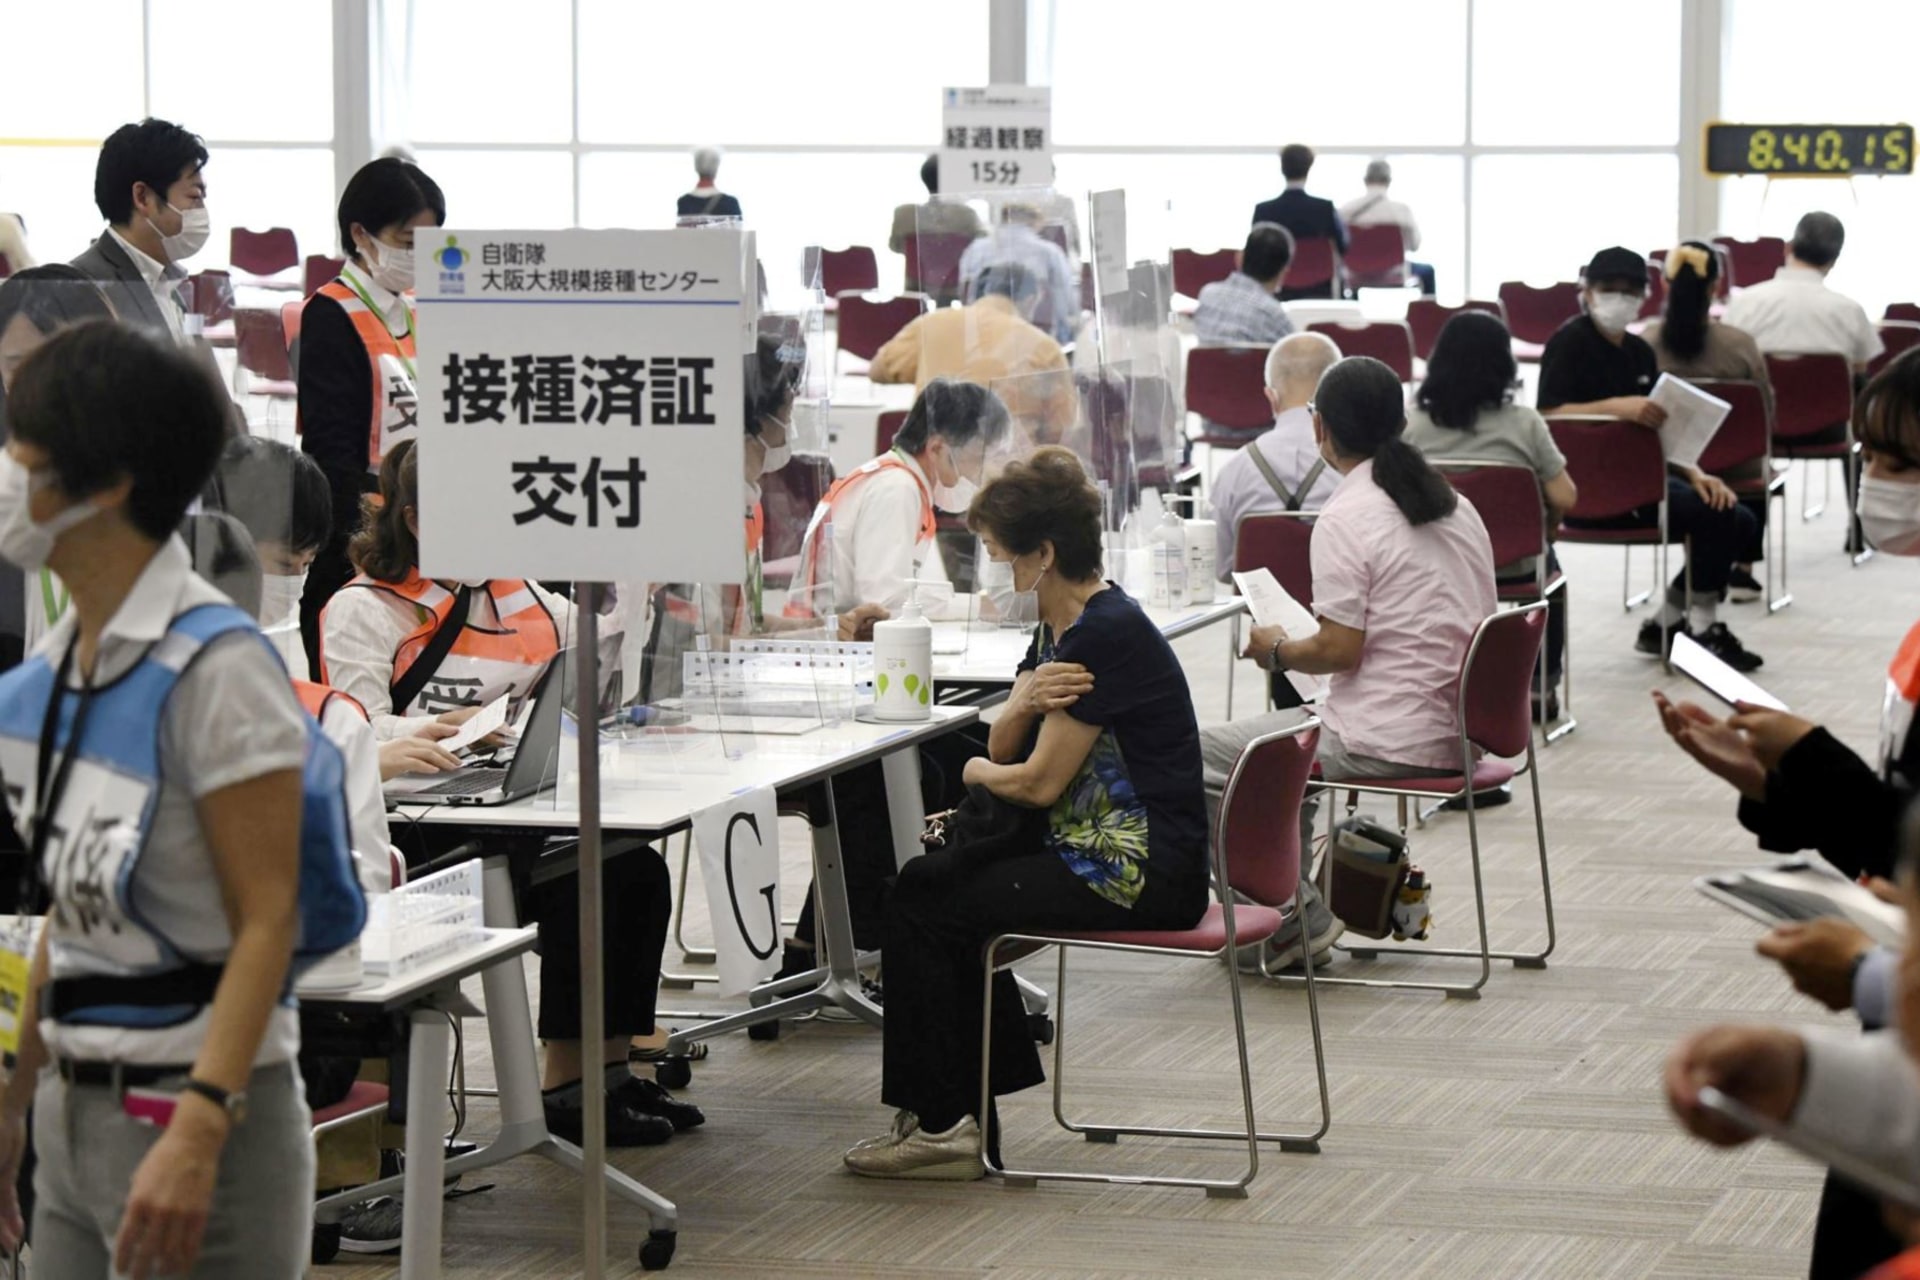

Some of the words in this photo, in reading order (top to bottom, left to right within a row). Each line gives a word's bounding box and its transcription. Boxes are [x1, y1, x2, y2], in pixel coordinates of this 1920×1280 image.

[946, 126, 1044, 150] 経過観察
[971, 161, 1020, 185] 15分
[482, 243, 546, 265] 自衛隊
[481, 269, 720, 292] 大阪大規模接種センター
[442, 353, 716, 426] 接種済証
[512, 456, 646, 528] 交付
[725, 812, 778, 960] G
